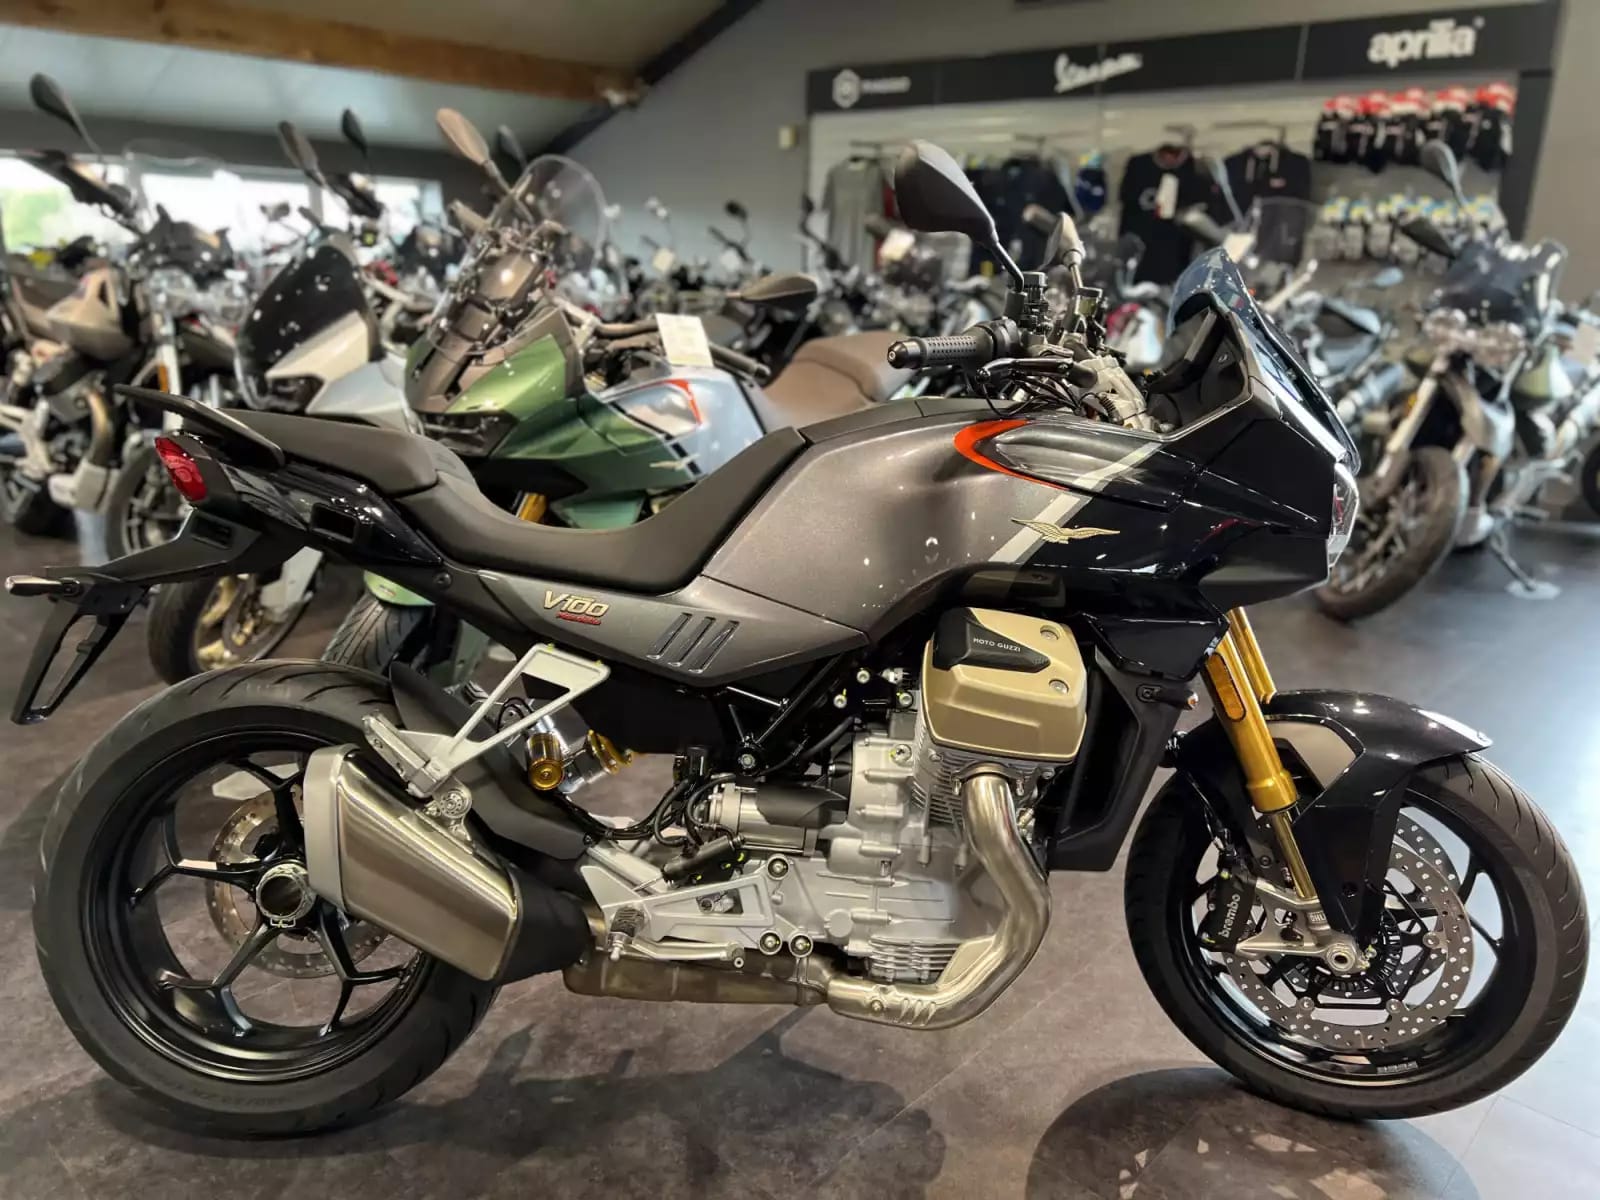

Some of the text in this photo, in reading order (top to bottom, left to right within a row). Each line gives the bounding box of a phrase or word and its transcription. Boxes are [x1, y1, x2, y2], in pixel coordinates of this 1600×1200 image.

[544, 590, 609, 617] V100
[973, 637, 1021, 653] MOTO GUZZI
[1218, 893, 1241, 938] brembo
